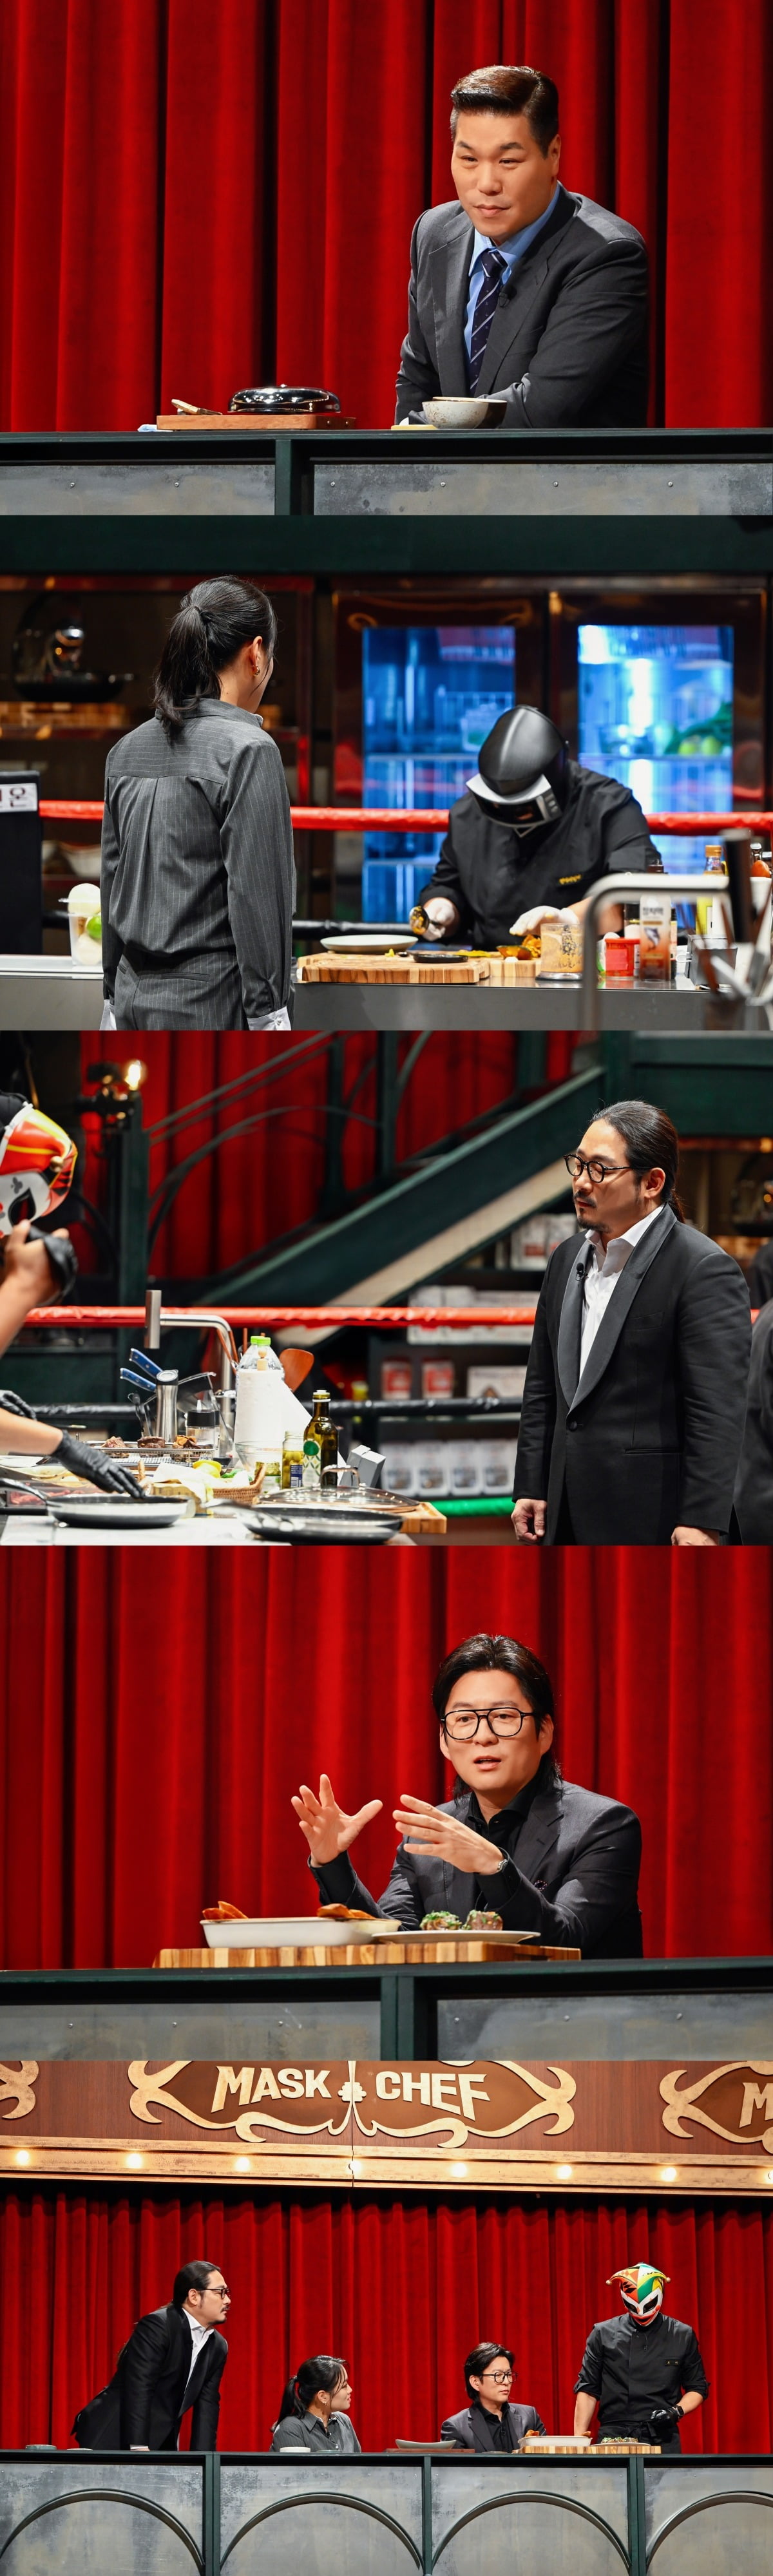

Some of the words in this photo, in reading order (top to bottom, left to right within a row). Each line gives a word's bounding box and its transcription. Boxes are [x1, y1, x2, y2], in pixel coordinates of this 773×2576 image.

[0, 787, 27, 808] 온
[211, 2066, 332, 2113] MASK
[376, 2071, 490, 2121] CHEF
